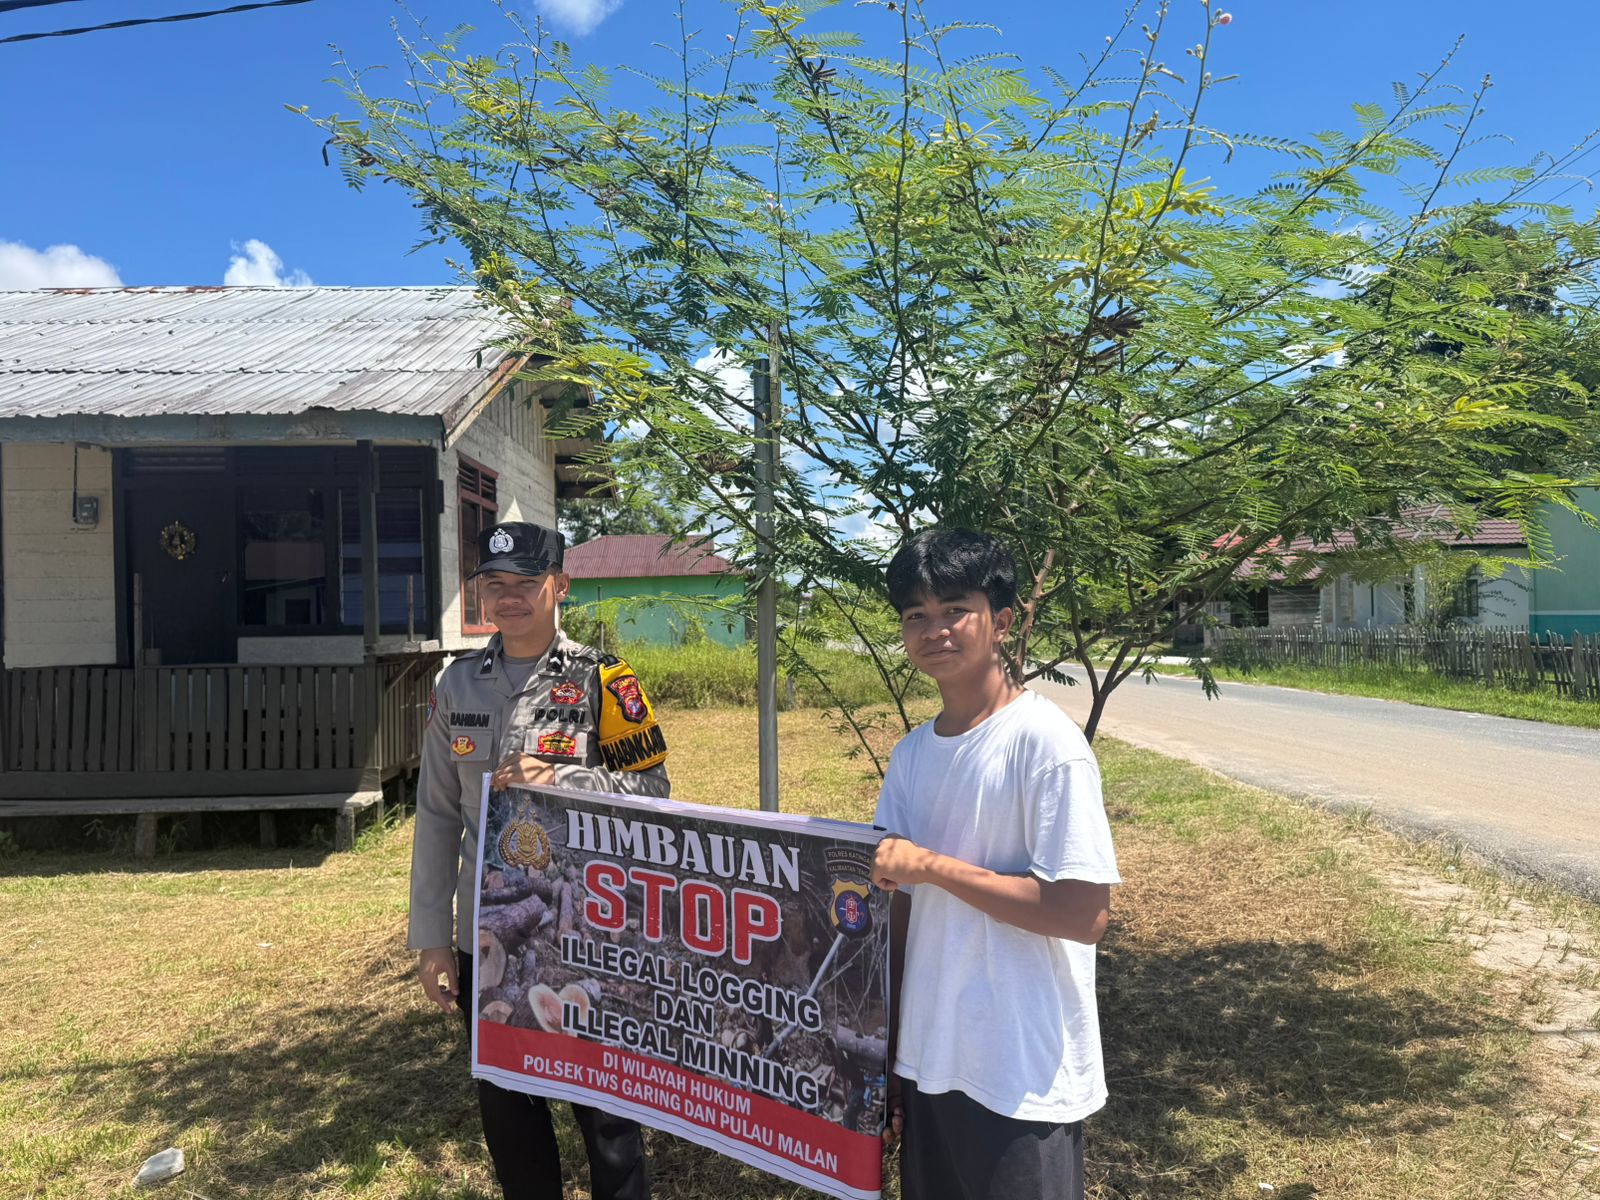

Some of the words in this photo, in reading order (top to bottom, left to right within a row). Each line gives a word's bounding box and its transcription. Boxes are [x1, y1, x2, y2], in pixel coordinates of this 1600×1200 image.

[534, 708, 586, 724] POLRI
[565, 808, 800, 892] HIMBAUAN
[584, 860, 782, 965] STOP
[561, 935, 676, 990] ILLEGAL
[681, 961, 822, 1031] LOGGING
[654, 991, 714, 1037] DAN
[562, 1001, 678, 1060] ILLEGAL
[683, 1036, 819, 1108] MINNING
[603, 1052, 618, 1070] DI
[622, 1055, 687, 1093] WILAYAH
[690, 1077, 751, 1115] HUKUM
[523, 1054, 583, 1082] POLSEK
[586, 1067, 618, 1091] TWS
[622, 1075, 681, 1111] GARING
[684, 1099, 717, 1126] DAN
[720, 1114, 774, 1147] PULAU
[777, 1132, 838, 1173] MALAN
